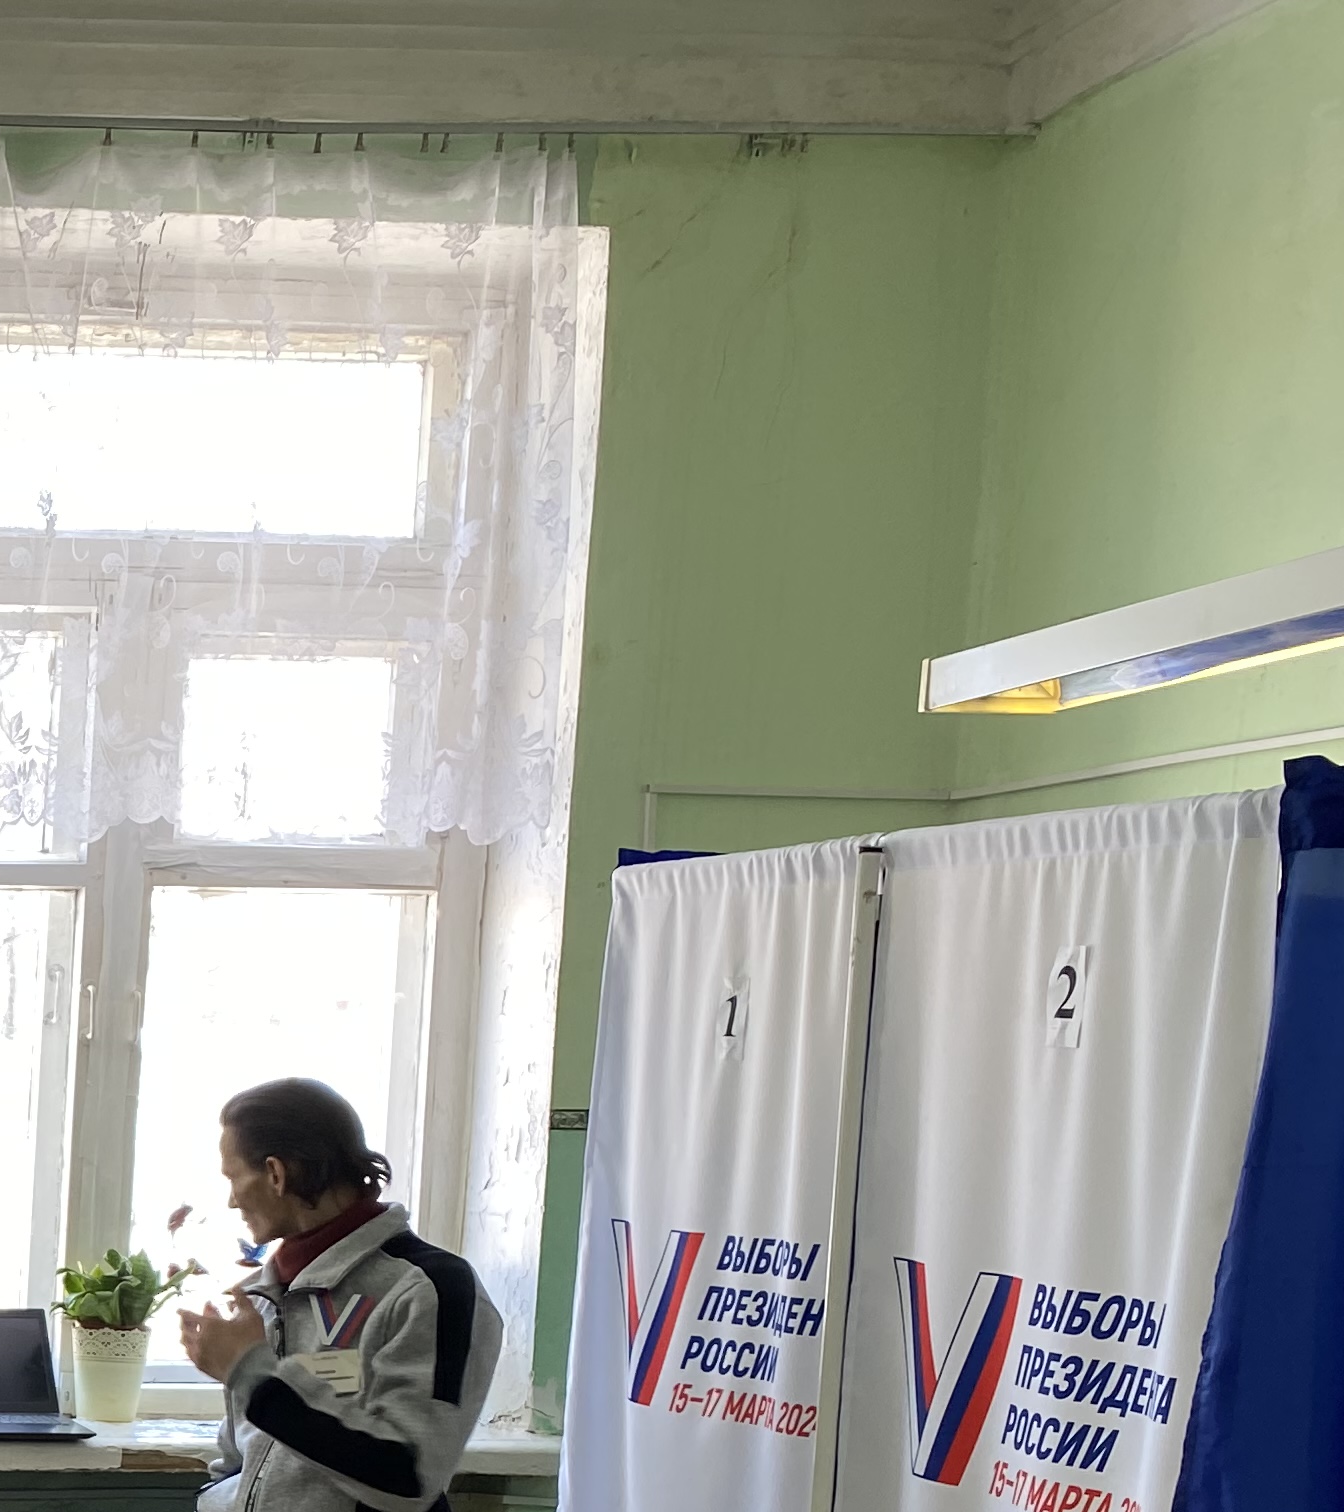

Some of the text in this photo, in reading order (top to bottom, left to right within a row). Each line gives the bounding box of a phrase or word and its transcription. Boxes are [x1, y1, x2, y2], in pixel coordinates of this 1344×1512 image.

[723, 995, 738, 1038] 1
[1054, 965, 1078, 1019] 2
[716, 1235, 821, 1281] ВЫБОРЫ
[697, 1285, 825, 1338] ПРЕЗИДЕН
[1028, 1283, 1167, 1349] ВЫБОРЫ
[680, 1335, 779, 1383] РОССИИ
[722, 1391, 775, 1430] МАРТА
[775, 1402, 817, 1437] 202
[1001, 1404, 1119, 1472] РОССИИ
